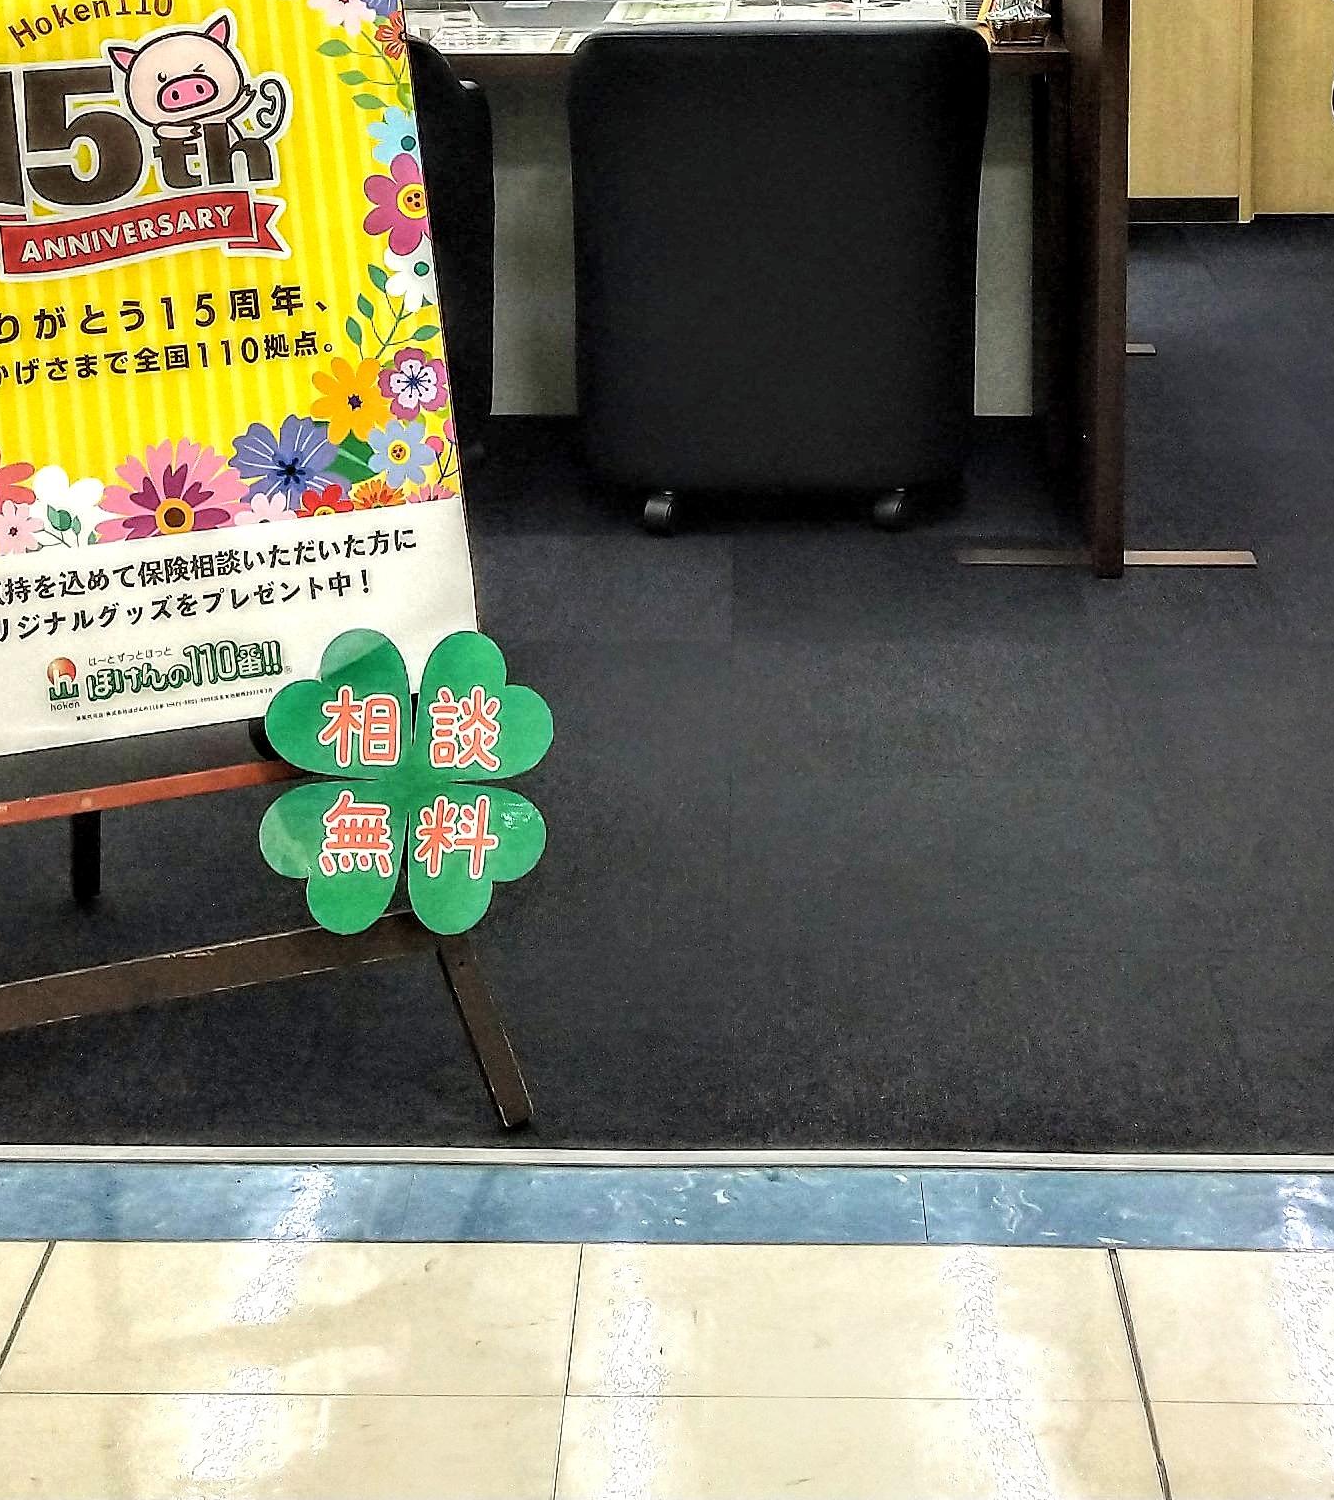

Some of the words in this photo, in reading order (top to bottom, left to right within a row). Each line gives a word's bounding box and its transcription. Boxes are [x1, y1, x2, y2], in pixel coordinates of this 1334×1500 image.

[21, 204, 235, 265] ANNIVERSARY
[49, 700, 81, 712] hoken
[319, 685, 504, 772] 相談
[319, 789, 500, 881] 無料
